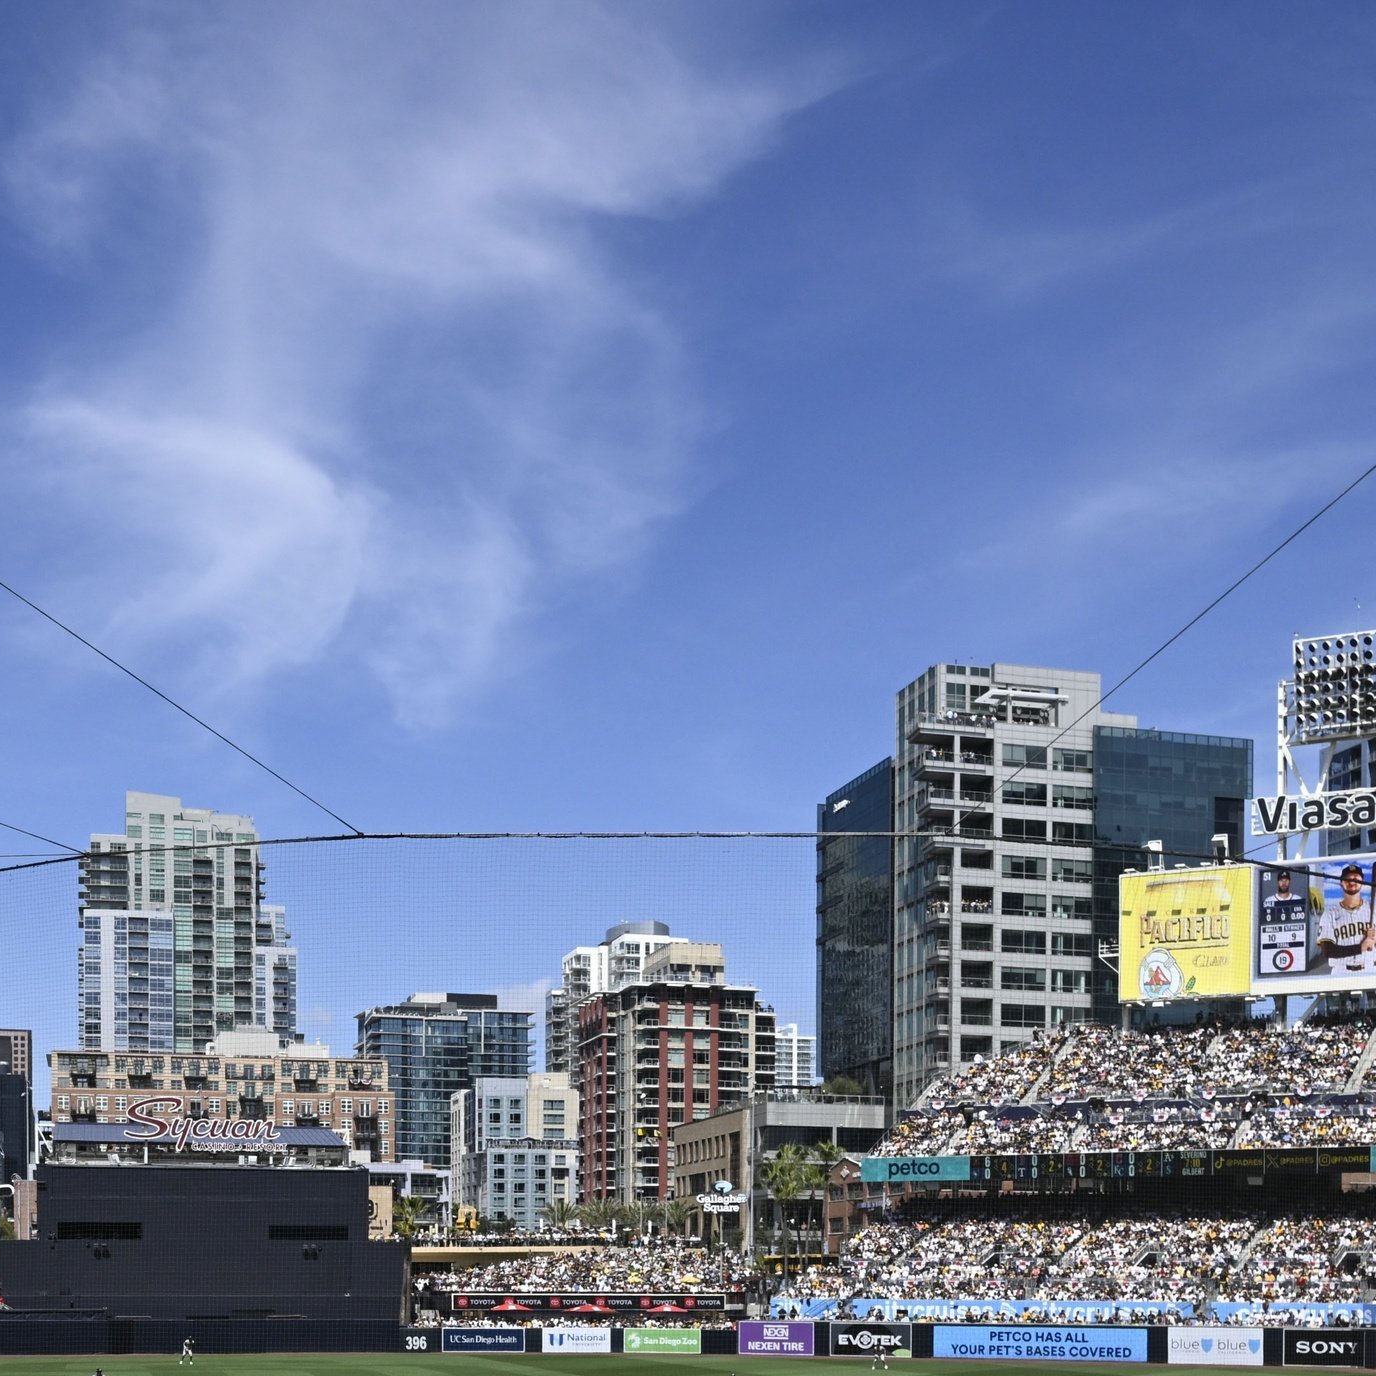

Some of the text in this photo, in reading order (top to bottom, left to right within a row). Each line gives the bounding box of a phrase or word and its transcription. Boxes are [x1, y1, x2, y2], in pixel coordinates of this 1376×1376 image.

[124, 1096, 282, 1152] Sycuan
[191, 1141, 288, 1152] CASINO RESORT
[888, 1159, 940, 1179] petco
[696, 1193, 747, 1207] Gallagher
[703, 1203, 739, 1214] Square
[405, 1335, 427, 1351] 396
[449, 1335, 517, 1346] UC San Diego Health
[567, 1333, 606, 1343] National
[643, 1337, 697, 1347] San Diego Zoo
[838, 1331, 902, 1349] EVOTEK
[989, 1331, 1089, 1343] PETCO HAS ALL
[748, 1341, 805, 1352] NEXEN TIRE
[1171, 1338, 1247, 1350] blue blue
[1296, 1340, 1358, 1354] SONY
[951, 1344, 1132, 1358] YOUR PET'S BASES COVERED
